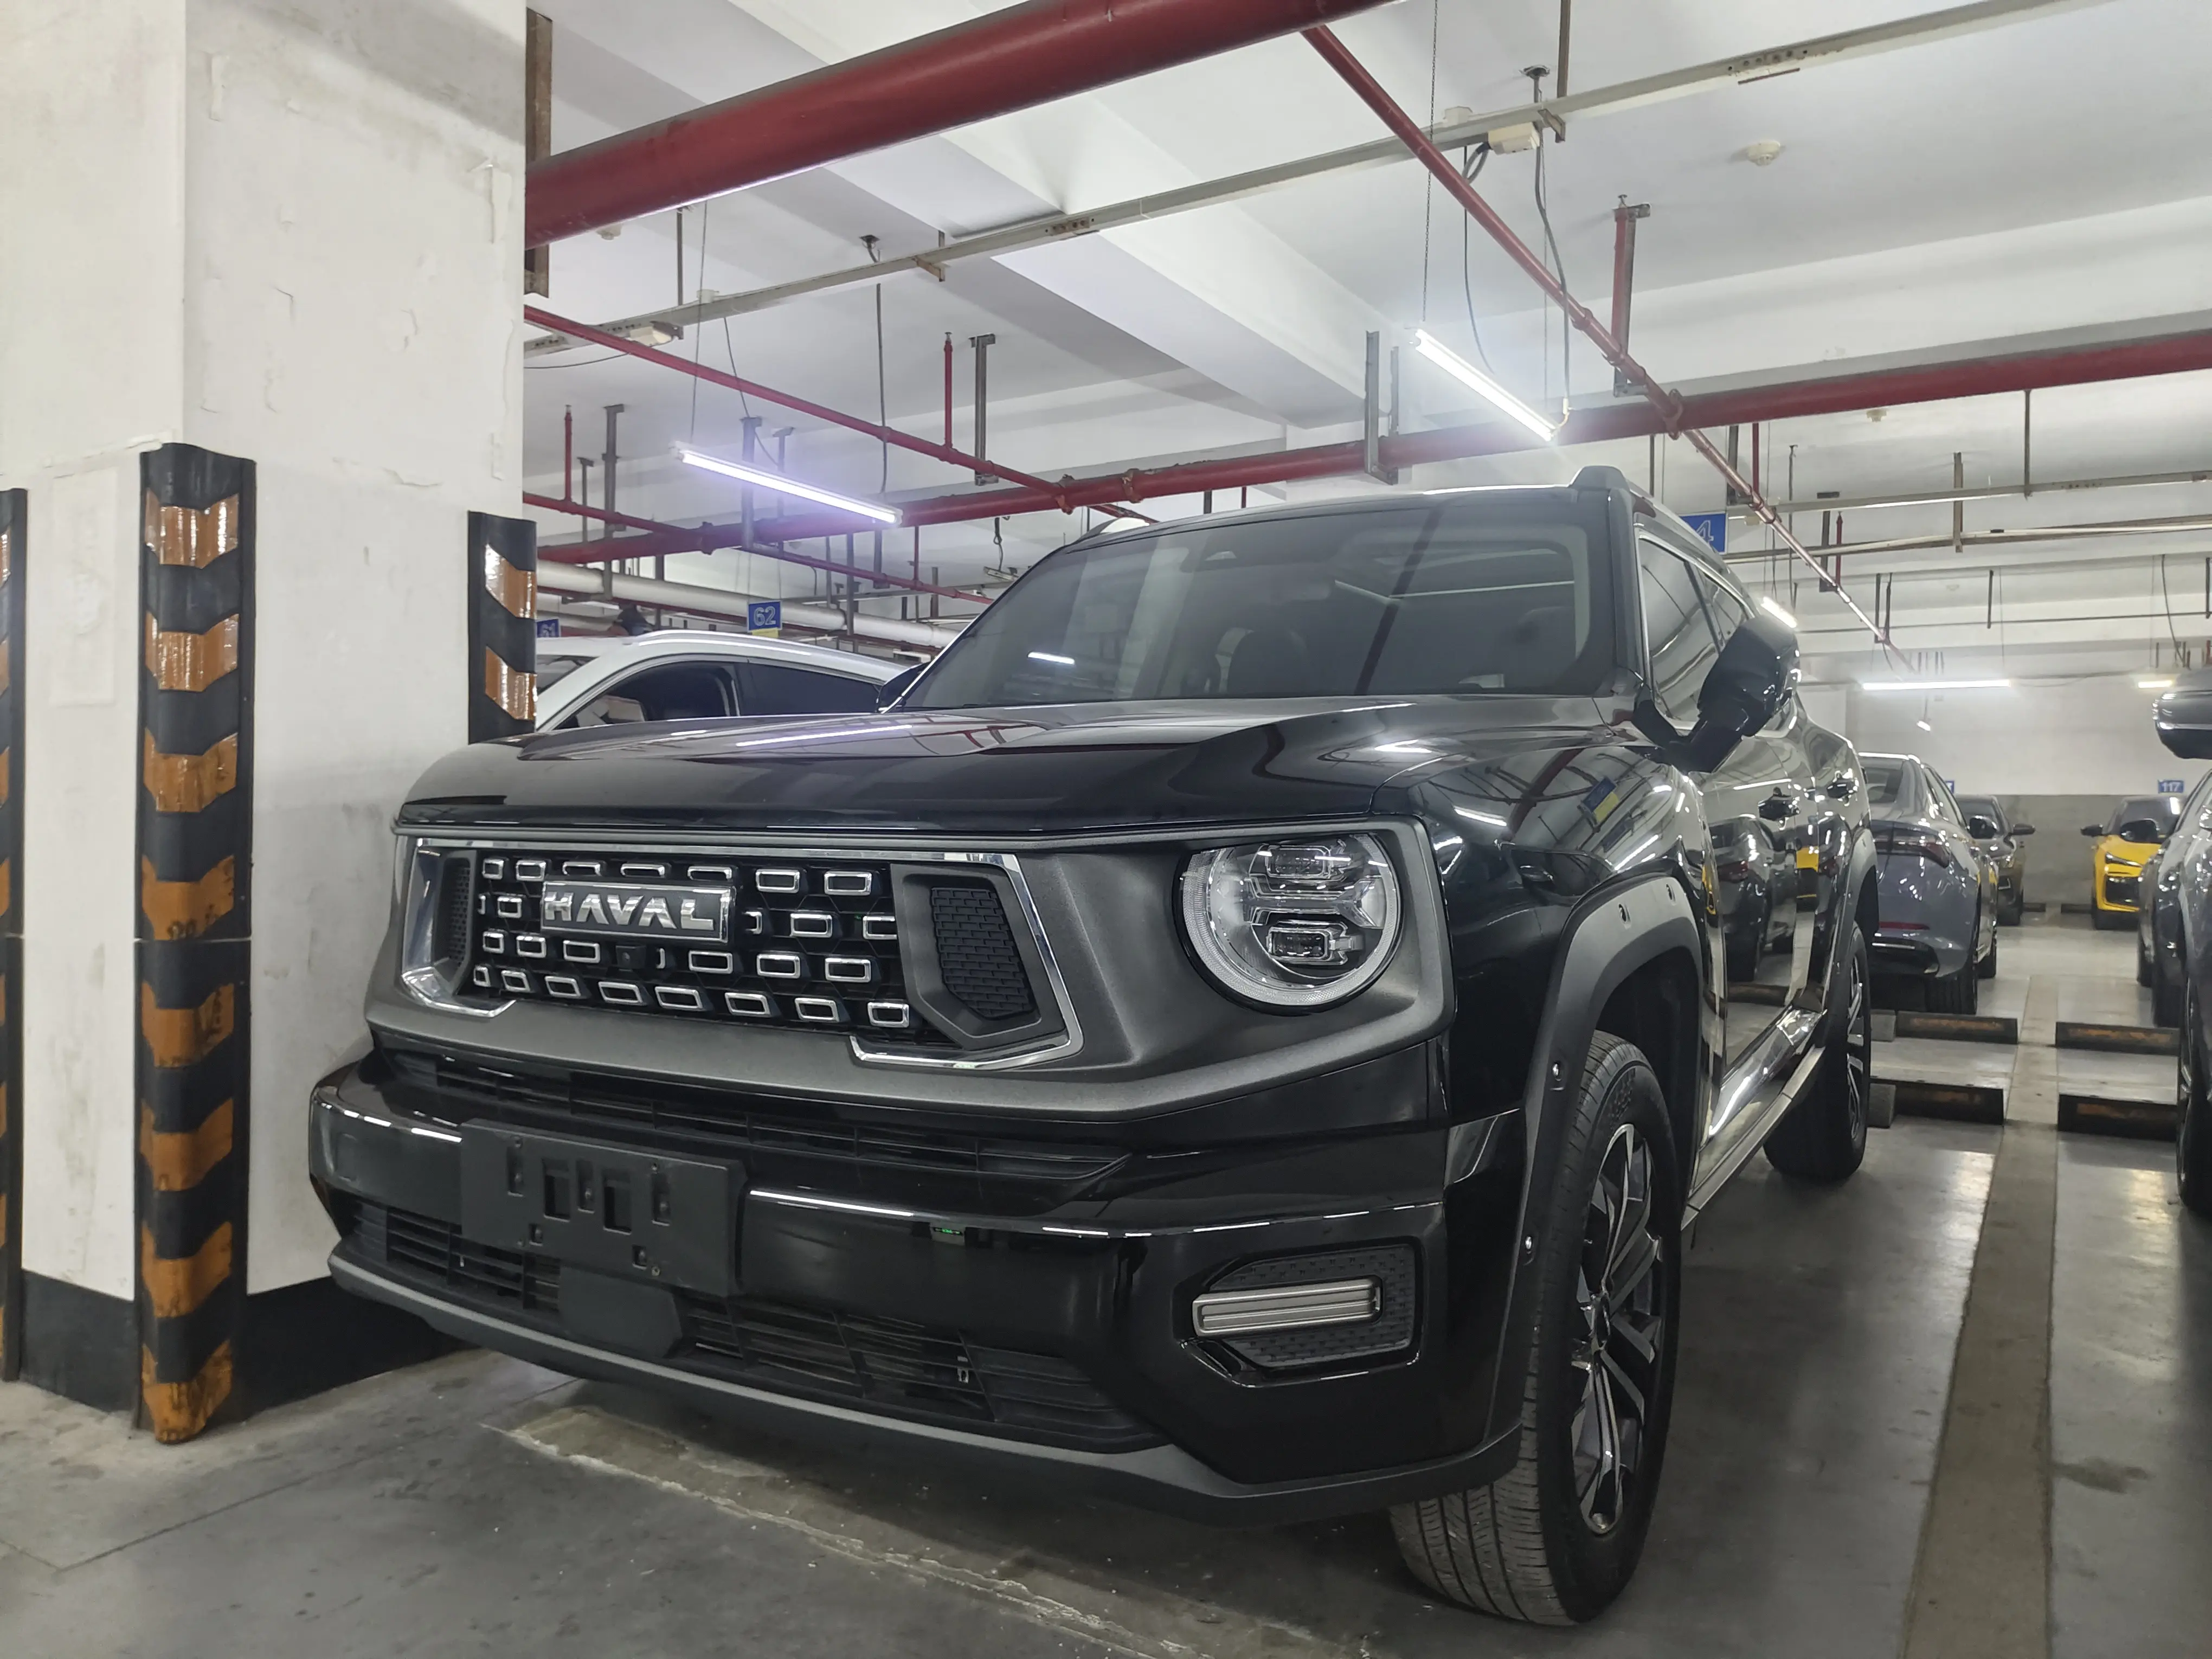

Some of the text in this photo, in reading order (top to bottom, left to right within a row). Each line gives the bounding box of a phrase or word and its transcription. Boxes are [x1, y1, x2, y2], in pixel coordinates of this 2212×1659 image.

[754, 606, 776, 626] 62
[2161, 781, 2181, 792] 117
[544, 891, 714, 931] HAVAL
